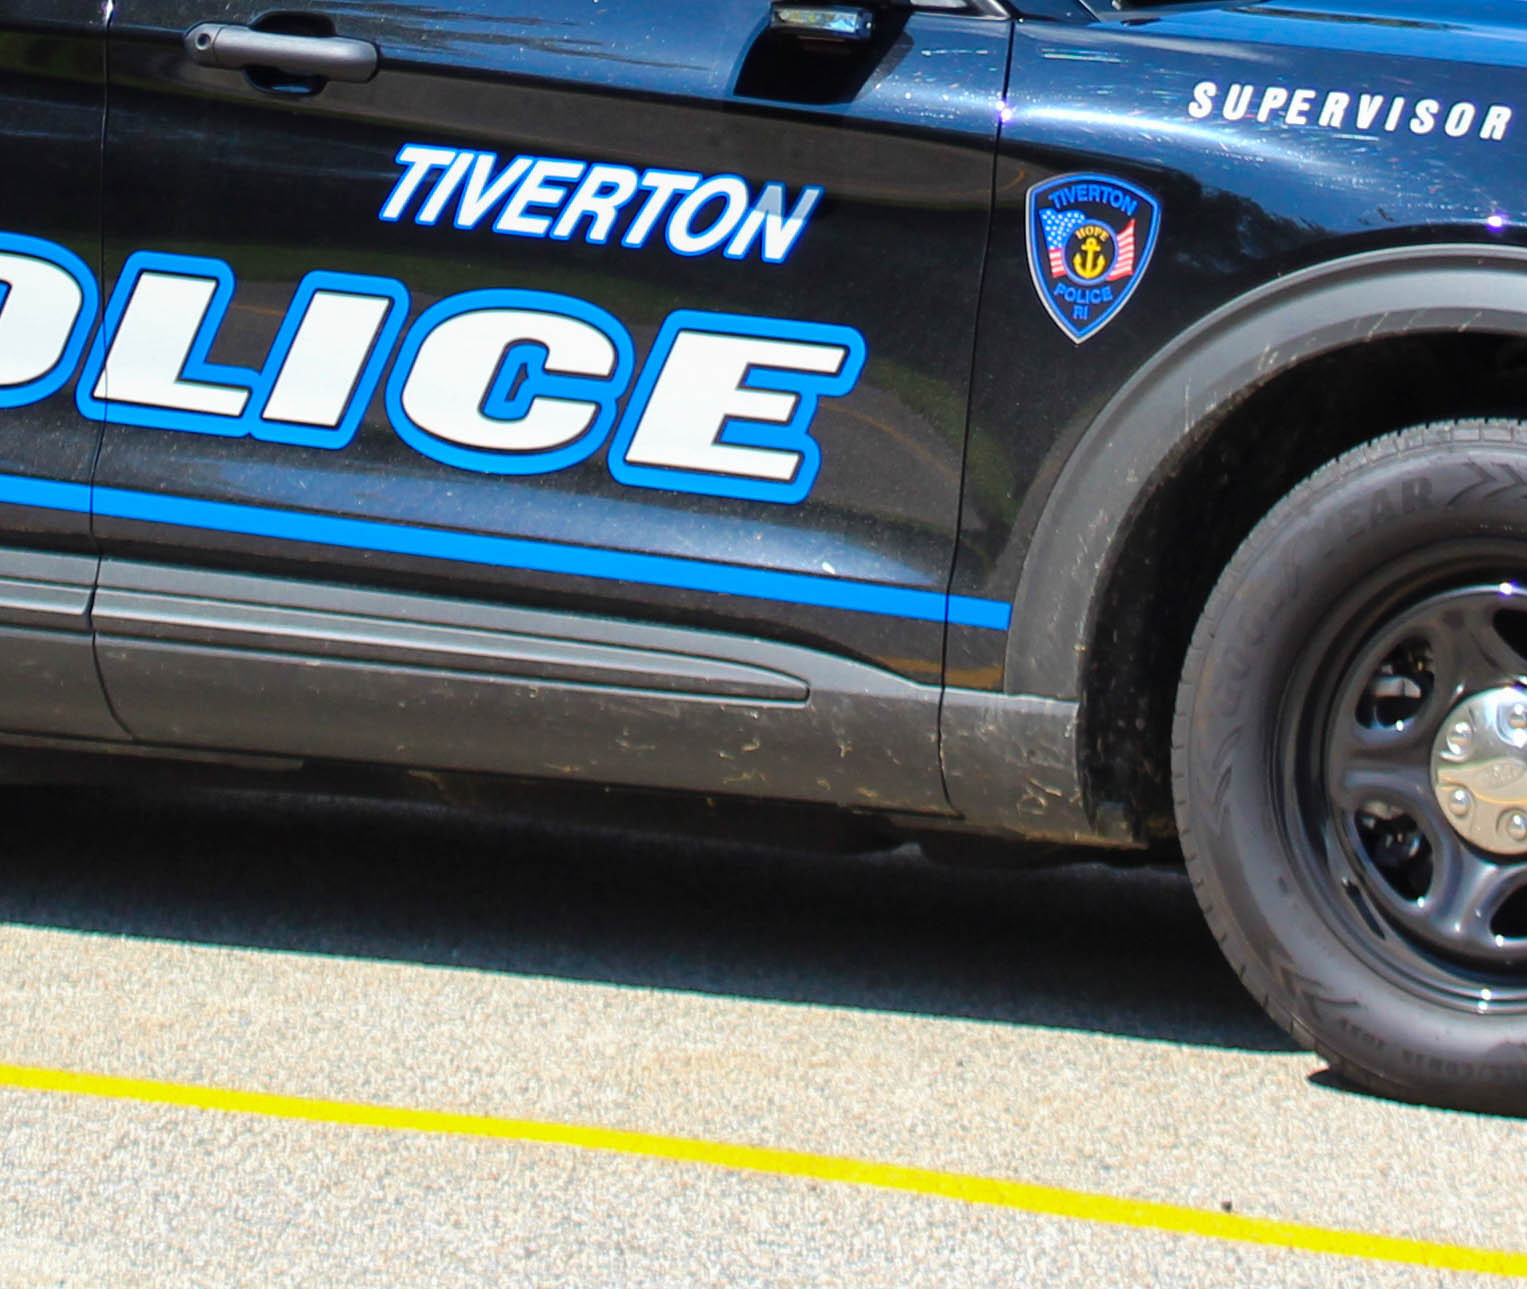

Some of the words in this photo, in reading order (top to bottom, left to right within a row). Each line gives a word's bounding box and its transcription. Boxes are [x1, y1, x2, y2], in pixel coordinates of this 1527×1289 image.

[1188, 81, 1512, 141] SUPERVISOR
[379, 143, 824, 263] TIVERTON
[1048, 184, 1138, 216] TIVERTON
[1074, 225, 1109, 242] HOPE
[1053, 282, 1113, 304] POLICE
[1072, 305, 1089, 320] RI
